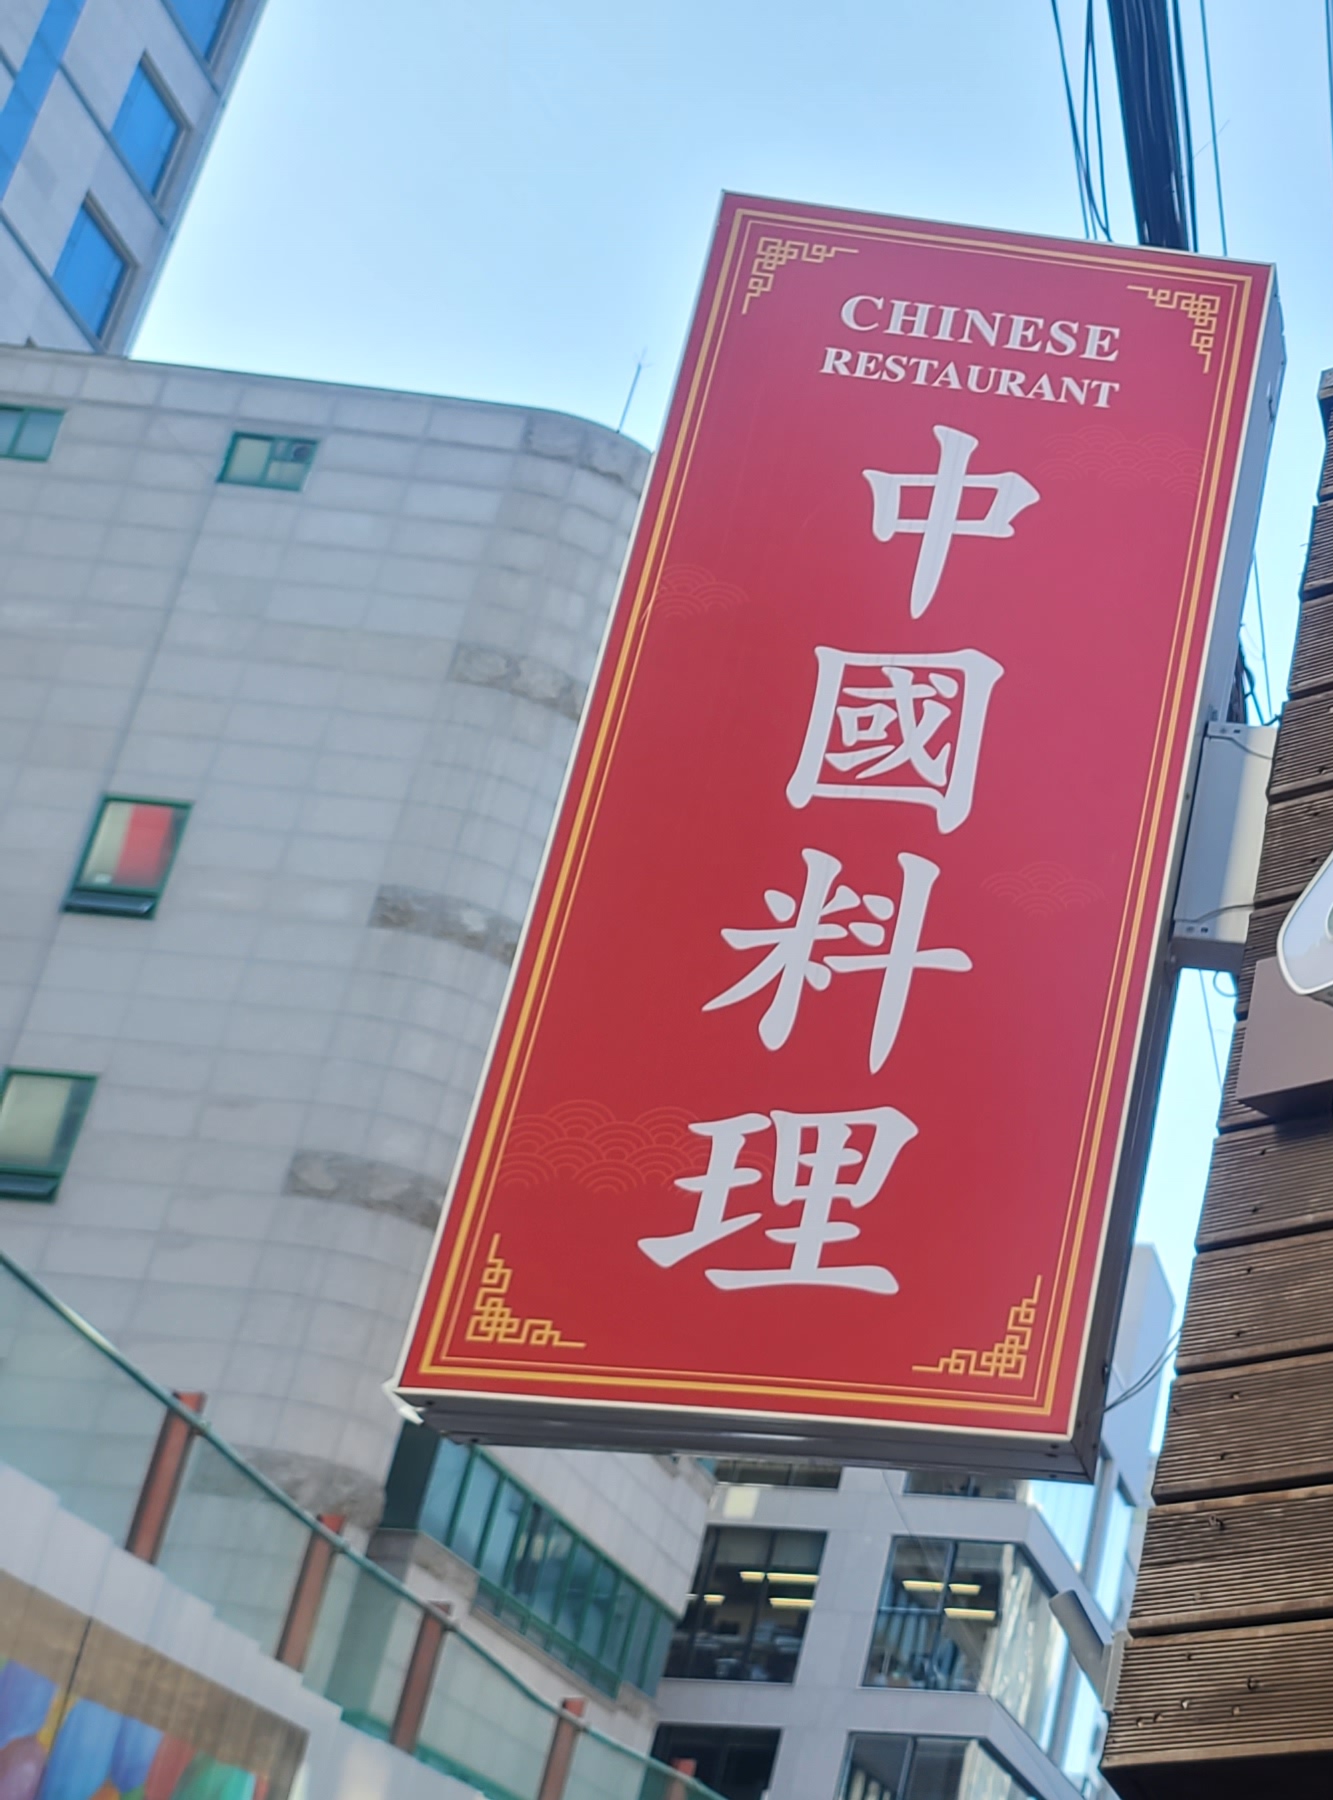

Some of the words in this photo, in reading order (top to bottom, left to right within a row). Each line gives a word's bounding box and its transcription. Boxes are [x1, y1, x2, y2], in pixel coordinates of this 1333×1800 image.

[841, 295, 1120, 362] CHINESE
[819, 347, 1120, 408] RESTAURANT
[637, 425, 1041, 1296] 中國料理
